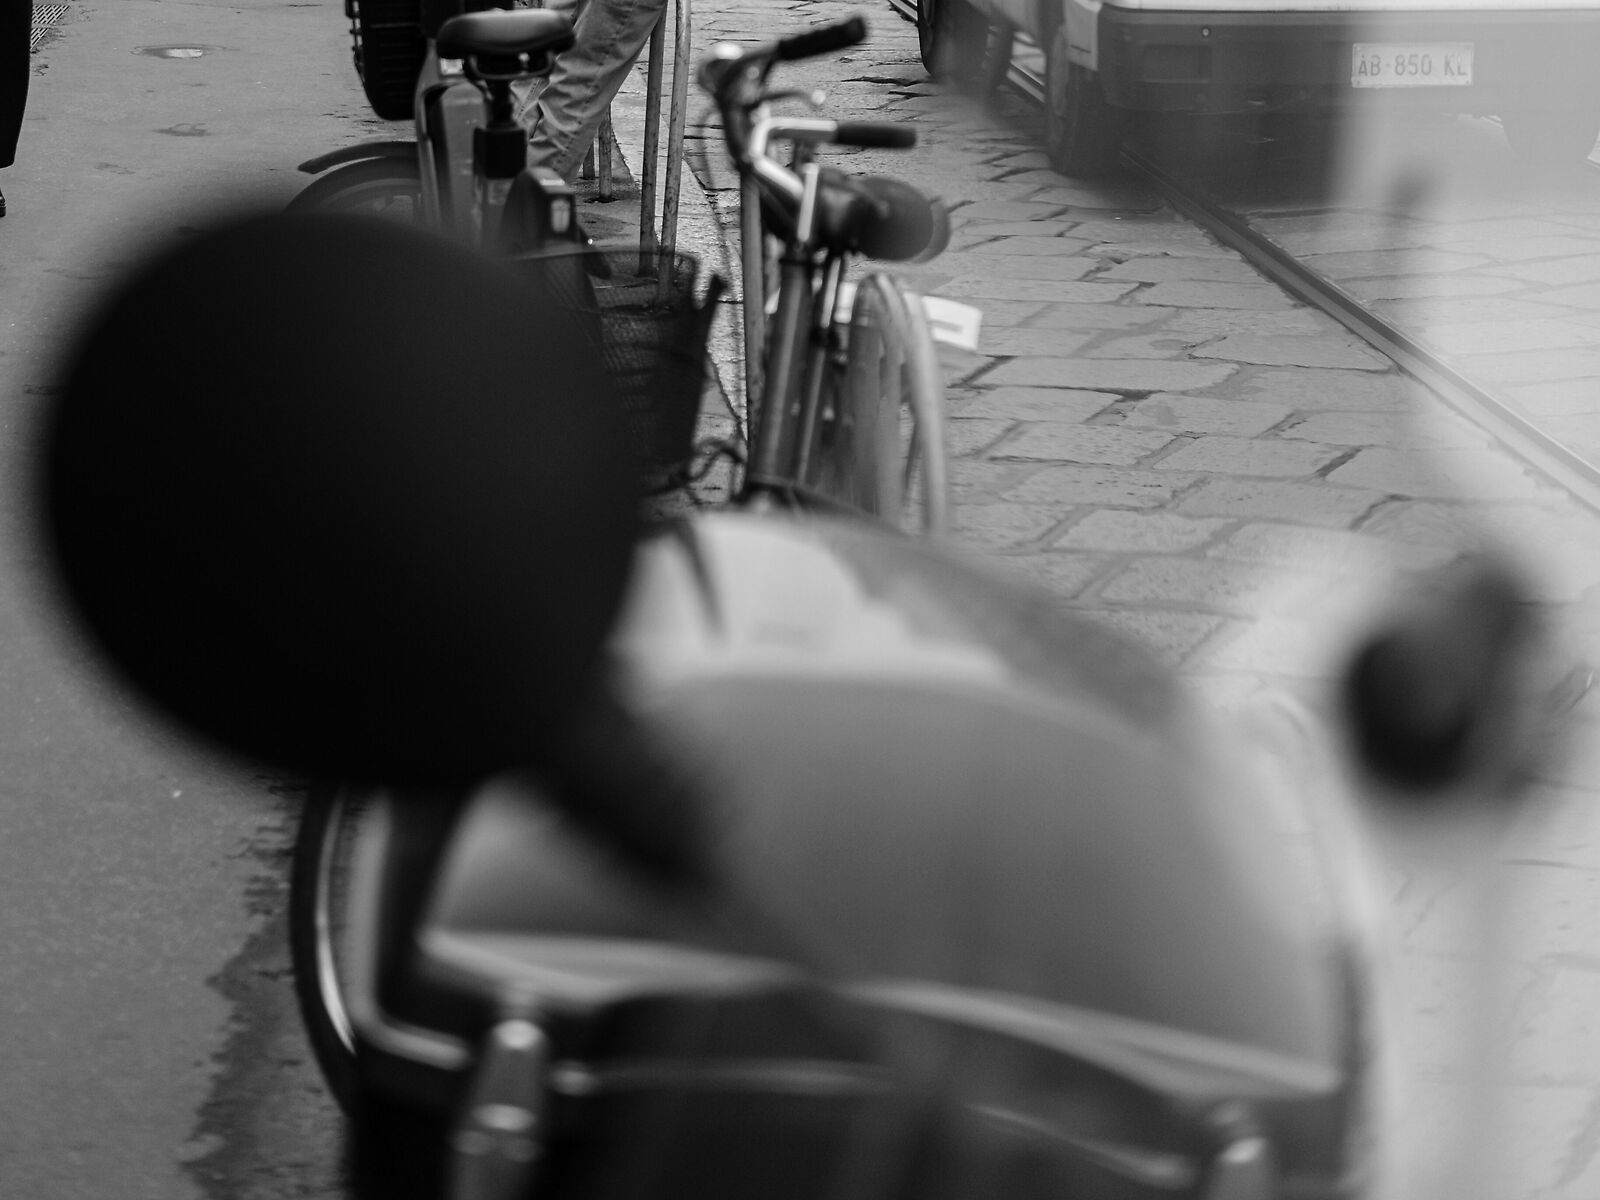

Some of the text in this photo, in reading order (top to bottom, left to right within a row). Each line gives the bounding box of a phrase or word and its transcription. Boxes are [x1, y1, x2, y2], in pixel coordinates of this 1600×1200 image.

[1358, 54, 1468, 77] AB 850 KL
